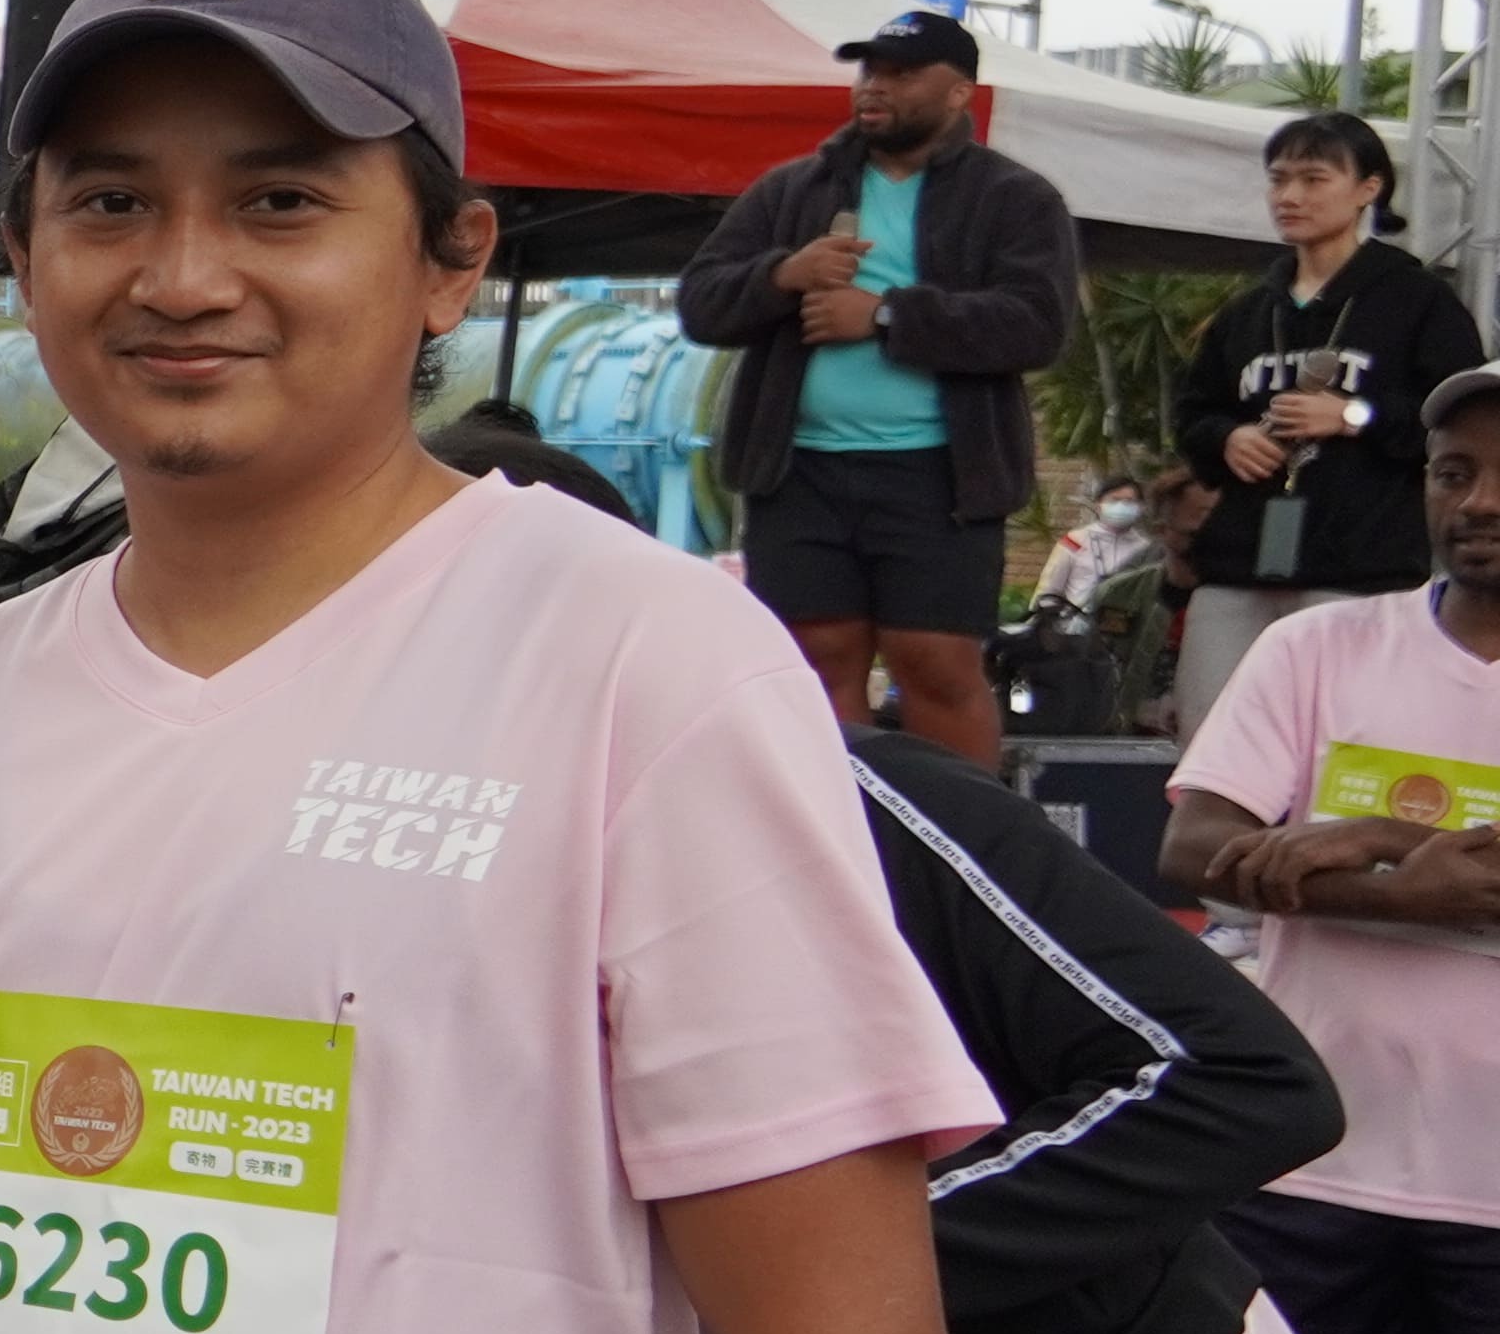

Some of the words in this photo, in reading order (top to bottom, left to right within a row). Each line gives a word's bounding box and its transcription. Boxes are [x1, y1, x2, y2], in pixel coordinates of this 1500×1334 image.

[301, 759, 525, 819] TAIWAN
[283, 796, 506, 883] TECH
[876, 788, 919, 827] adidas
[919, 826, 963, 865] adidas
[963, 866, 1003, 910] adidas
[1005, 910, 1048, 953] adidas
[1049, 952, 1096, 994] adidas
[1096, 992, 1145, 1029] adidas
[151, 1068, 259, 1104] TAIWAN
[262, 1081, 334, 1112] TECH
[90, 1119, 116, 1132] TECH
[169, 1107, 228, 1135] RUN
[241, 1115, 312, 1145] 2023
[186, 1149, 216, 1169] 寄物
[244, 1158, 293, 1179] 完賽禮
